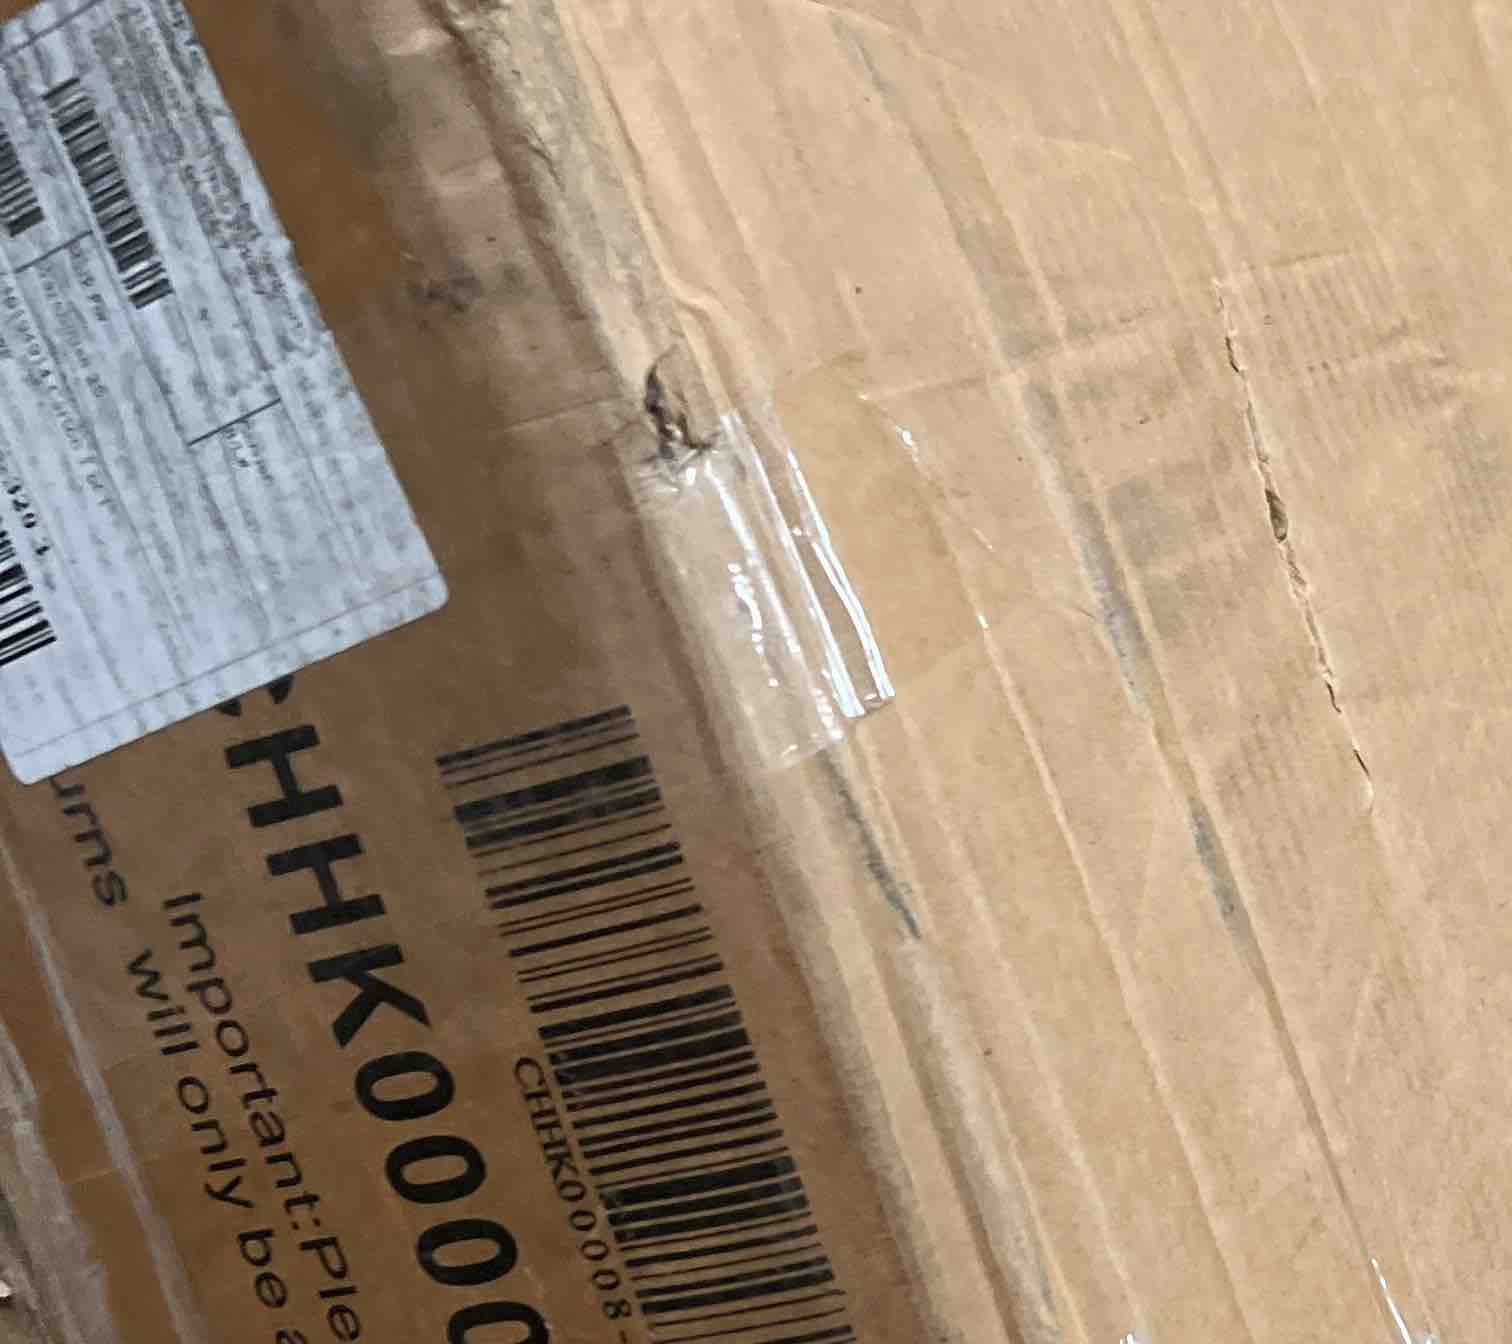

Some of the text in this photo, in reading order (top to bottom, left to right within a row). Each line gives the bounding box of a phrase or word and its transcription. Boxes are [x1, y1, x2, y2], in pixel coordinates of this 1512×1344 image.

[126, 947, 198, 1057] will
[176, 1075, 255, 1211] only
[237, 1230, 291, 1311] be
